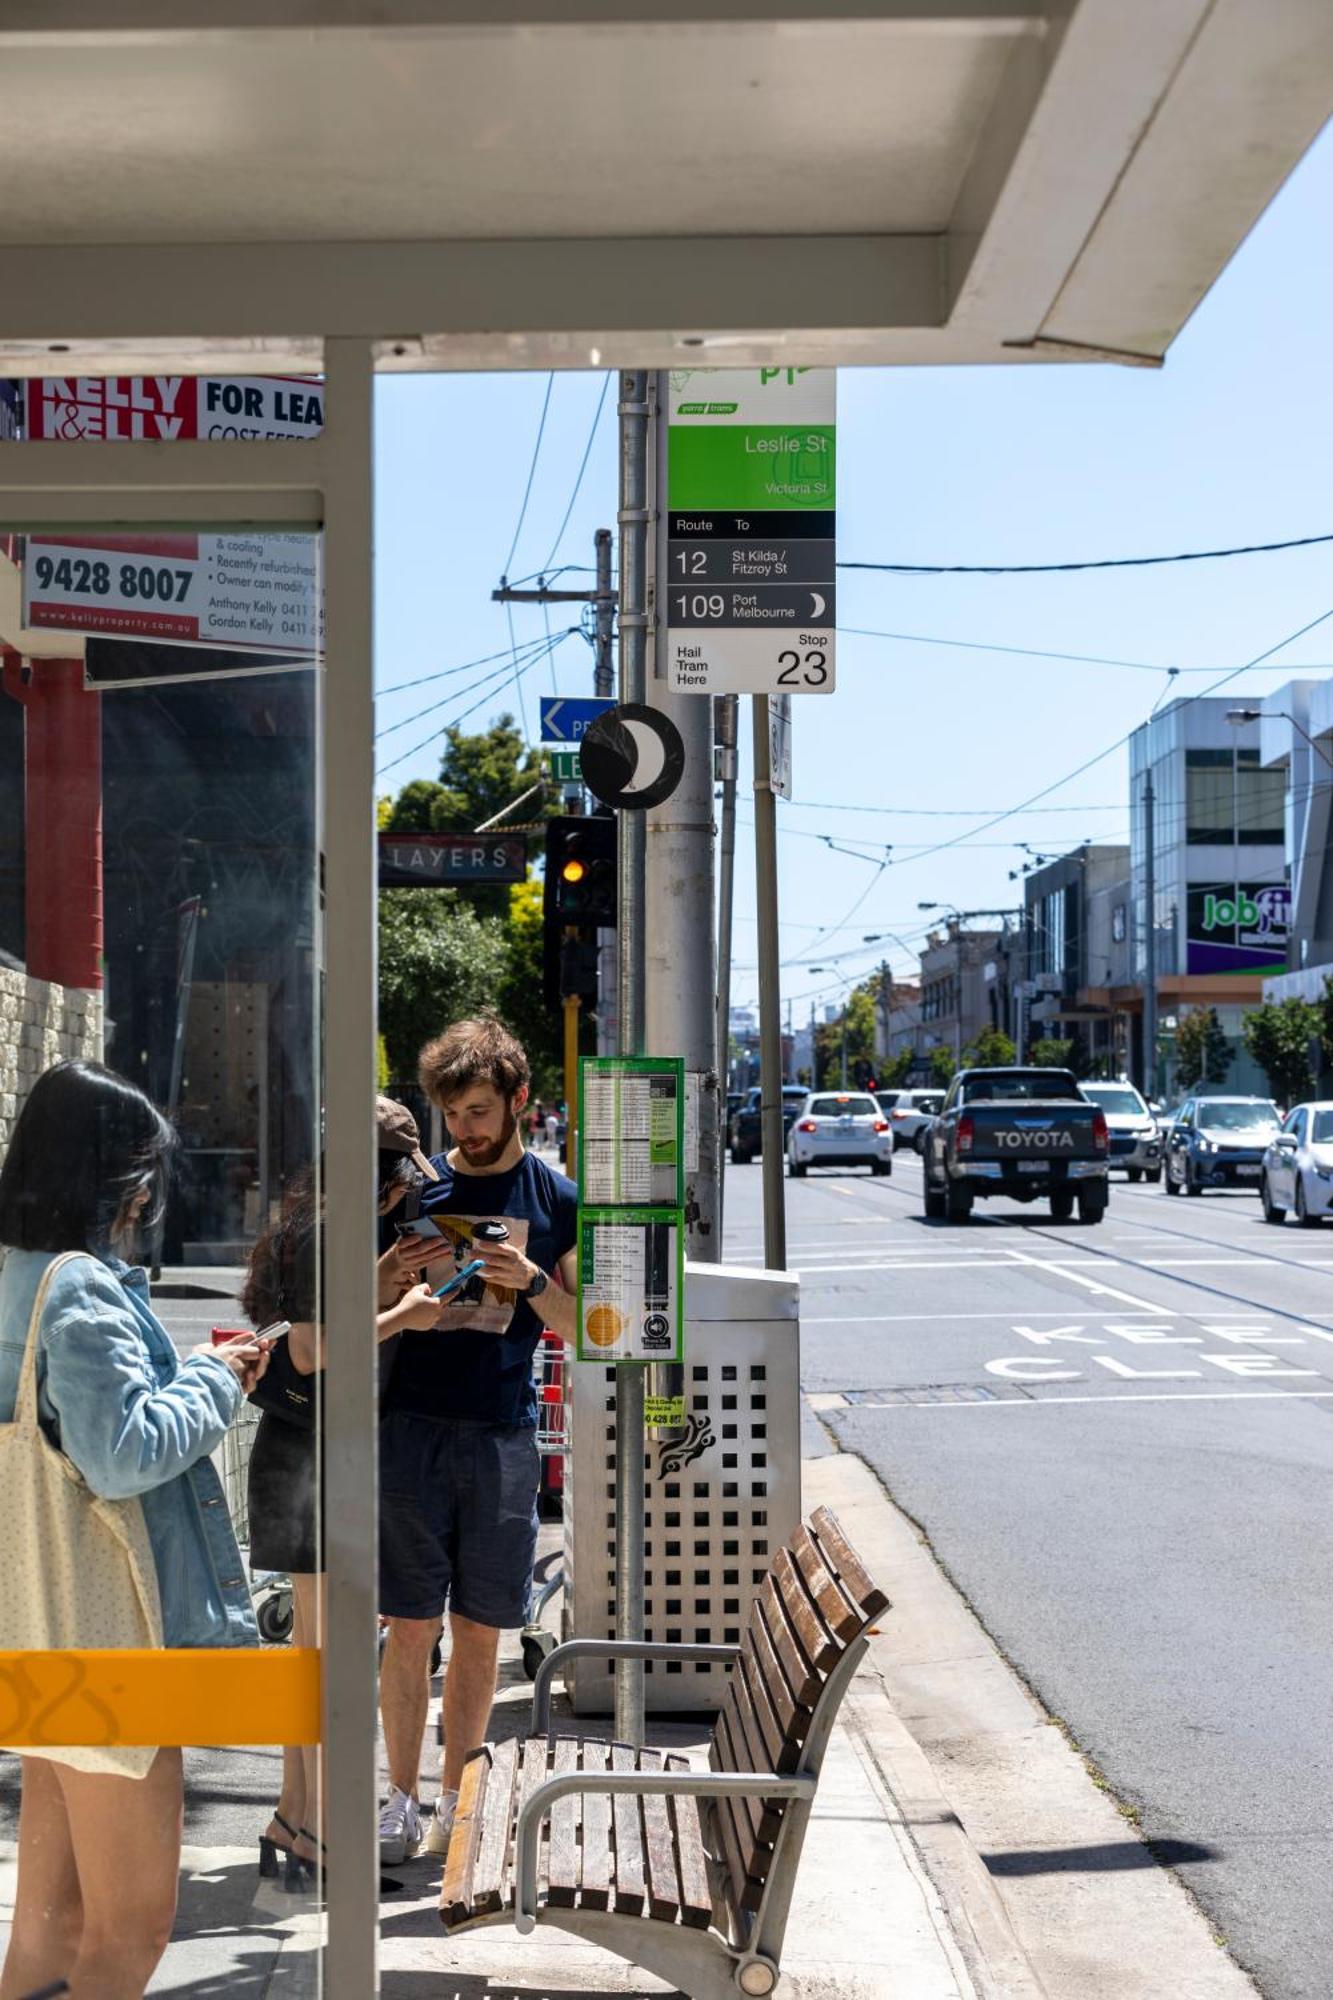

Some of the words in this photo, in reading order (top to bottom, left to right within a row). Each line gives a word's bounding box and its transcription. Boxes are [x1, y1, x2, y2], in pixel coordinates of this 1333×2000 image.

[207, 382, 264, 418] FOR
[274, 391, 324, 426] LEA
[745, 436, 799, 453] Leslie
[806, 435, 828, 453] St
[766, 482, 810, 494] Victoria
[814, 482, 827, 494] St
[676, 519, 713, 531] Route
[735, 519, 750, 531] To
[227, 541, 264, 557] cooling
[217, 554, 258, 573] Recently
[676, 551, 707, 575] 12
[732, 550, 745, 562] St
[748, 550, 778, 562] Kilda
[732, 562, 771, 576] Fitzroy
[774, 563, 788, 575] St
[36, 556, 110, 595] 9428
[119, 565, 193, 602] 8007
[217, 572, 251, 587] Owner
[254, 579, 272, 590] can
[209, 596, 251, 614] Anthony
[254, 600, 277, 616] Kelly
[676, 594, 725, 618] 109
[732, 594, 757, 606] Port
[732, 606, 796, 618] Melbourne
[208, 613, 247, 630] Gordon
[250, 617, 274, 634] Kelly
[799, 634, 828, 648] Stop
[677, 646, 701, 658] Hail
[676, 659, 709, 672] Tram
[777, 650, 828, 686] 23
[677, 674, 707, 685] Here
[393, 848, 507, 869] LAYERS
[994, 1131, 1075, 1148] TOYOTA
